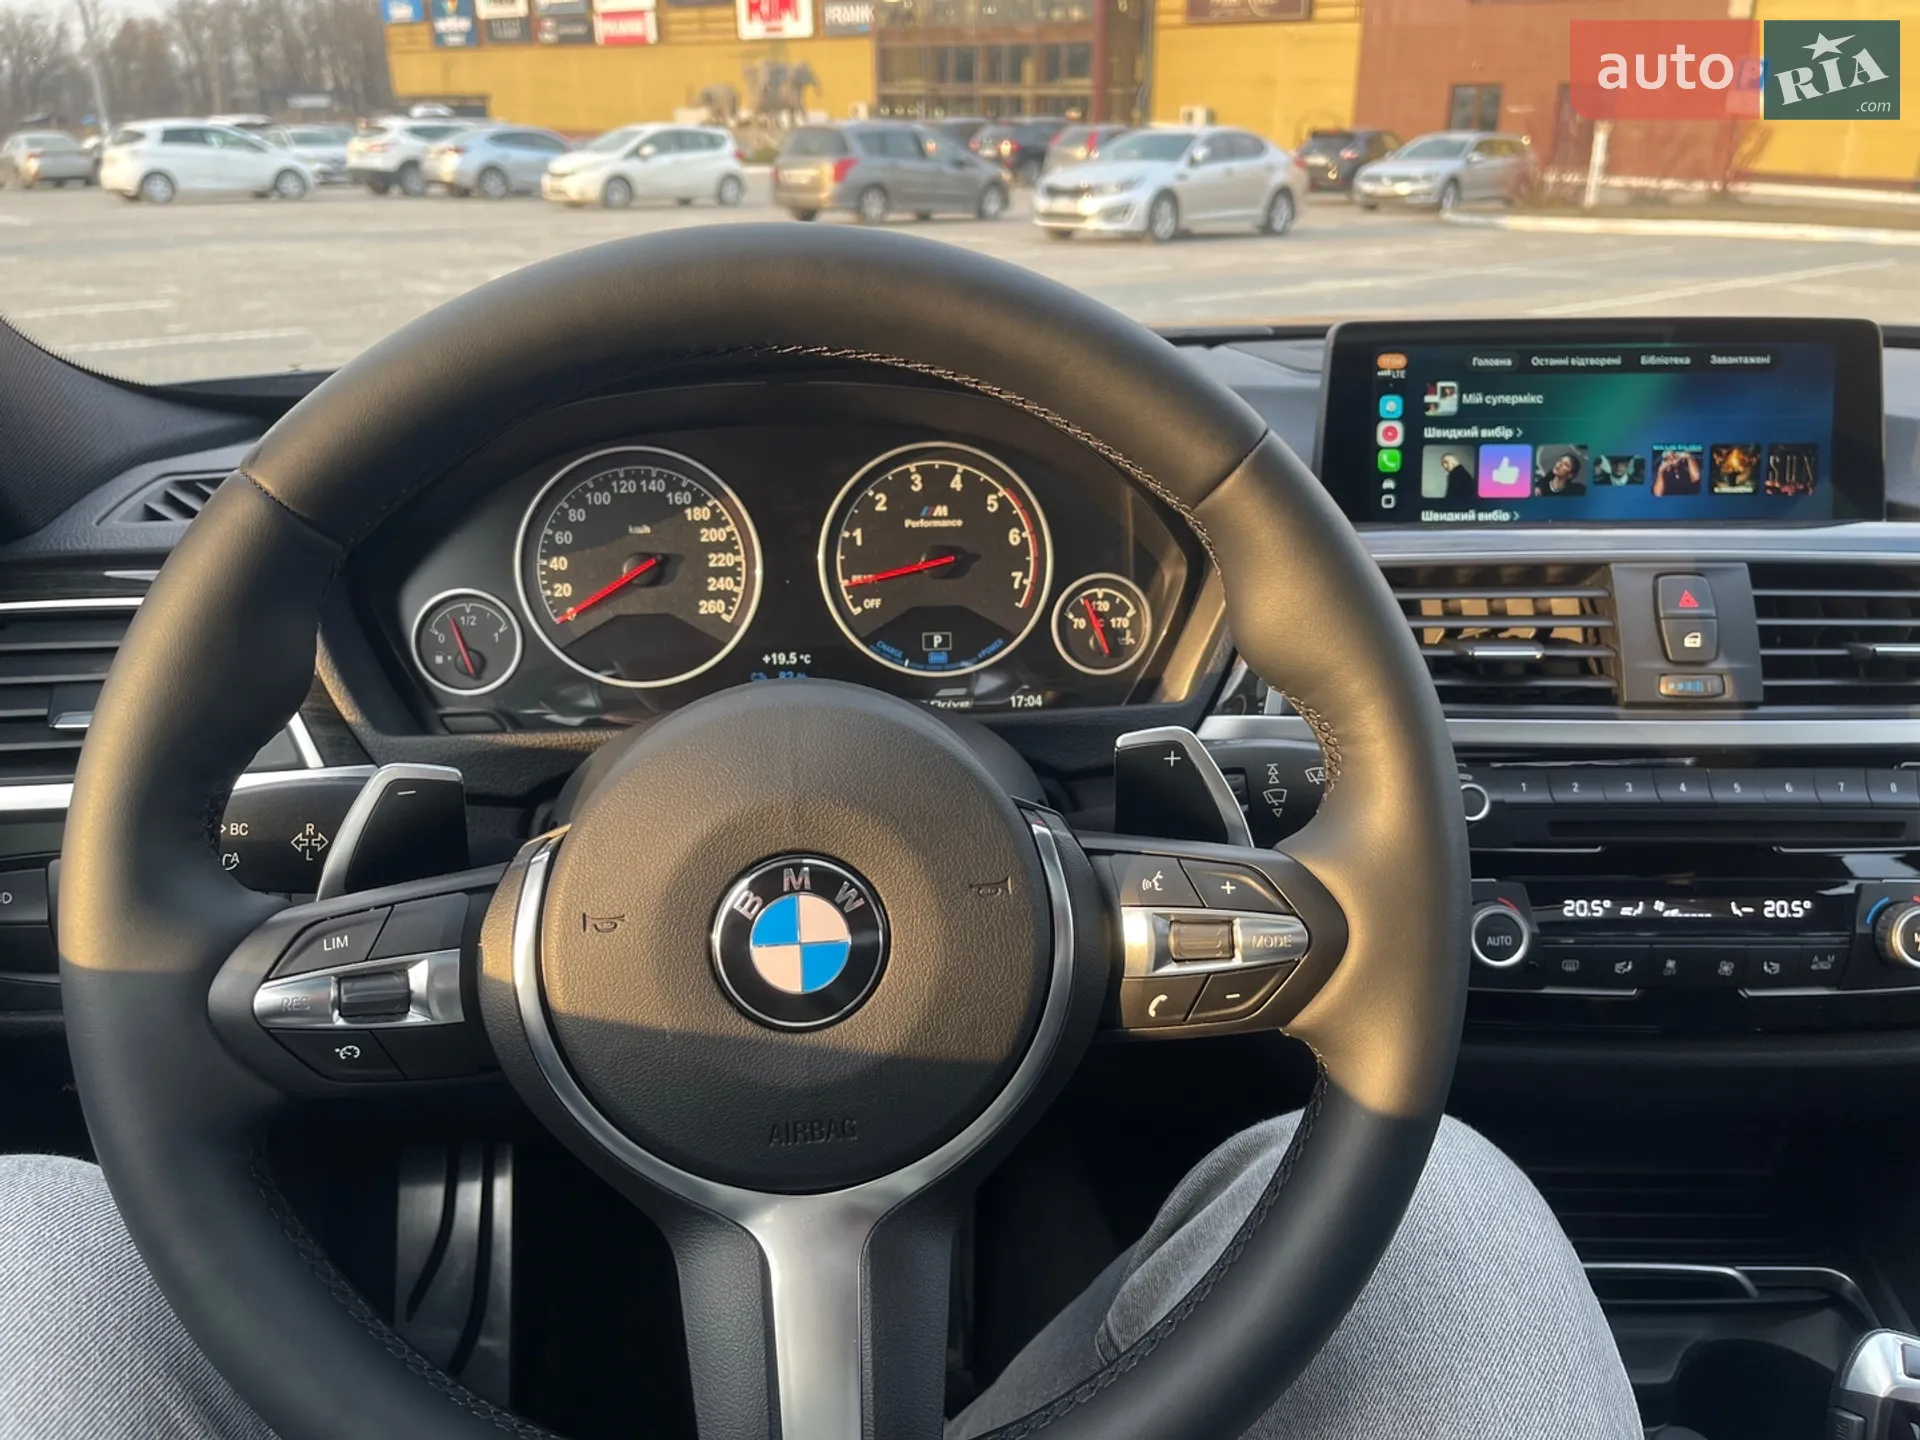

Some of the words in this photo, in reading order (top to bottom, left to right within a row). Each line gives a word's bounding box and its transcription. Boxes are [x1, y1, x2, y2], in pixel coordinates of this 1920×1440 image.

[1472, 355, 1513, 367] Головна
[1531, 355, 1569, 367] Останні
[1570, 355, 1622, 368] відтворені
[1640, 355, 1691, 366] Бібліотека
[1709, 354, 1772, 365] Завантажені
[1392, 369, 1406, 379] LTE
[1462, 392, 1483, 404] Мій
[1485, 393, 1544, 406] супермікс
[1424, 426, 1479, 439] Швидкий
[1480, 425, 1514, 438] вибір
[612, 480, 636, 493] 120
[640, 479, 665, 492] 140
[911, 474, 922, 491] 3
[950, 474, 963, 491] 4
[586, 492, 611, 505] 100
[666, 492, 692, 505] 160
[875, 493, 888, 511] 2
[986, 495, 999, 513] 5
[568, 508, 586, 522] 80
[684, 507, 711, 521] 180
[1421, 509, 1476, 522] Швидкий
[904, 518, 963, 528] Performance
[554, 531, 573, 544] 60
[700, 528, 726, 542] 200
[852, 528, 862, 546] 1
[1008, 528, 1021, 546] 6
[549, 557, 568, 571] 40
[708, 553, 735, 567] 220
[707, 577, 734, 592] 240
[1011, 572, 1024, 589] 7
[553, 583, 572, 597] 20
[698, 600, 725, 615] 260
[863, 598, 881, 609] OFF
[460, 615, 476, 626] 1/2
[1073, 617, 1086, 629] 70
[1110, 617, 1130, 628] 170
[438, 633, 445, 643] 0
[494, 632, 499, 643] 1
[933, 634, 942, 648] P
[762, 651, 797, 665] +19.5
[1010, 695, 1043, 708] 17:04
[1521, 782, 1527, 792] 1
[1572, 782, 1580, 793] 2
[1625, 782, 1633, 793] 3
[1679, 782, 1687, 793] 4
[1733, 782, 1741, 794] 5
[1785, 782, 1793, 793] 6
[1838, 782, 1844, 793] 7
[1890, 782, 1897, 793] 8
[230, 823, 249, 836] BC
[306, 823, 315, 835] R
[306, 849, 313, 861] L
[734, 867, 865, 920] BMW
[1563, 899, 1611, 917] 20.5°
[1762, 899, 1812, 918] 20.5°
[323, 935, 349, 951] LIM
[1251, 934, 1292, 949] MODE
[1486, 935, 1512, 947] AUTO
[281, 997, 311, 1011] RES
[769, 1118, 859, 1146] AIRBAG
